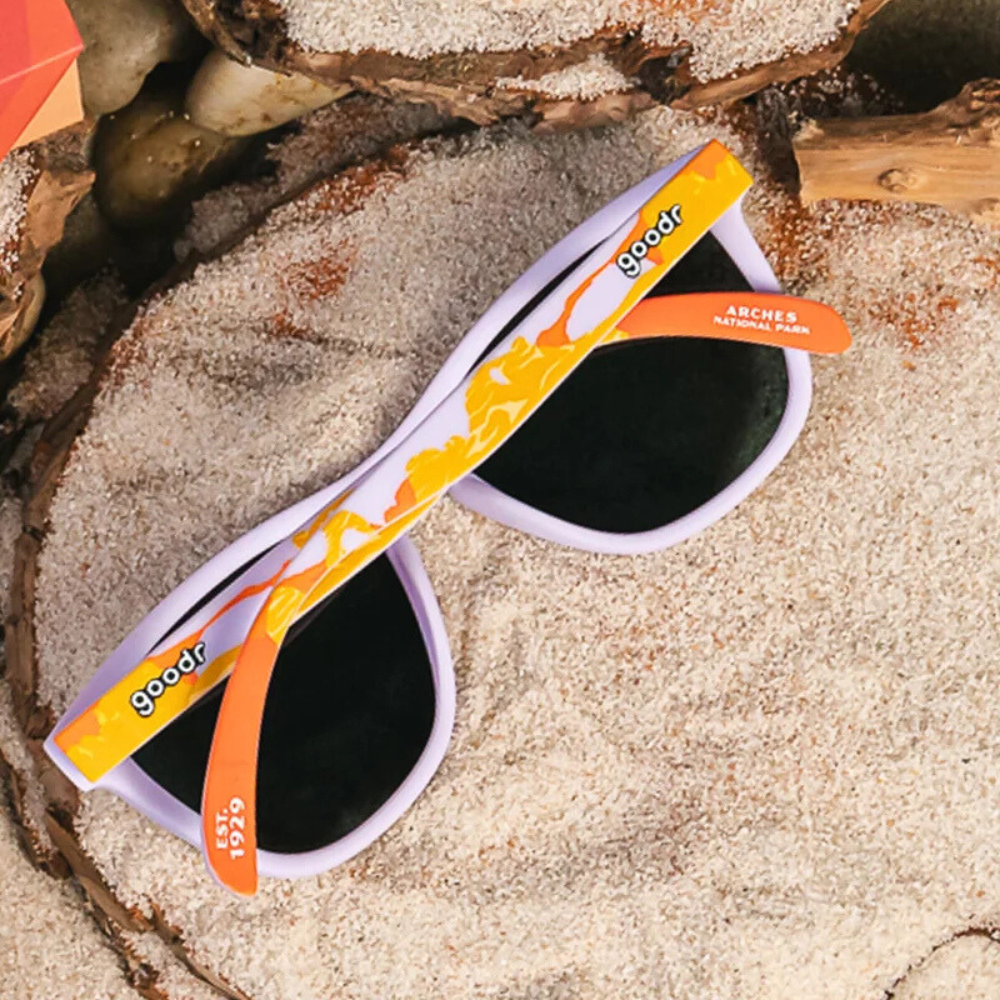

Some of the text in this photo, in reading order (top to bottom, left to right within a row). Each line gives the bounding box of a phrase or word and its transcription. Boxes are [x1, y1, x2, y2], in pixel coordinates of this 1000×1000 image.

[616, 203, 683, 279] goodr
[712, 315, 811, 336] NATIONAL PARK
[726, 304, 798, 324] ARCHES
[130, 641, 206, 718] goodr
[215, 807, 229, 850] EST.
[229, 796, 246, 861] 1929
